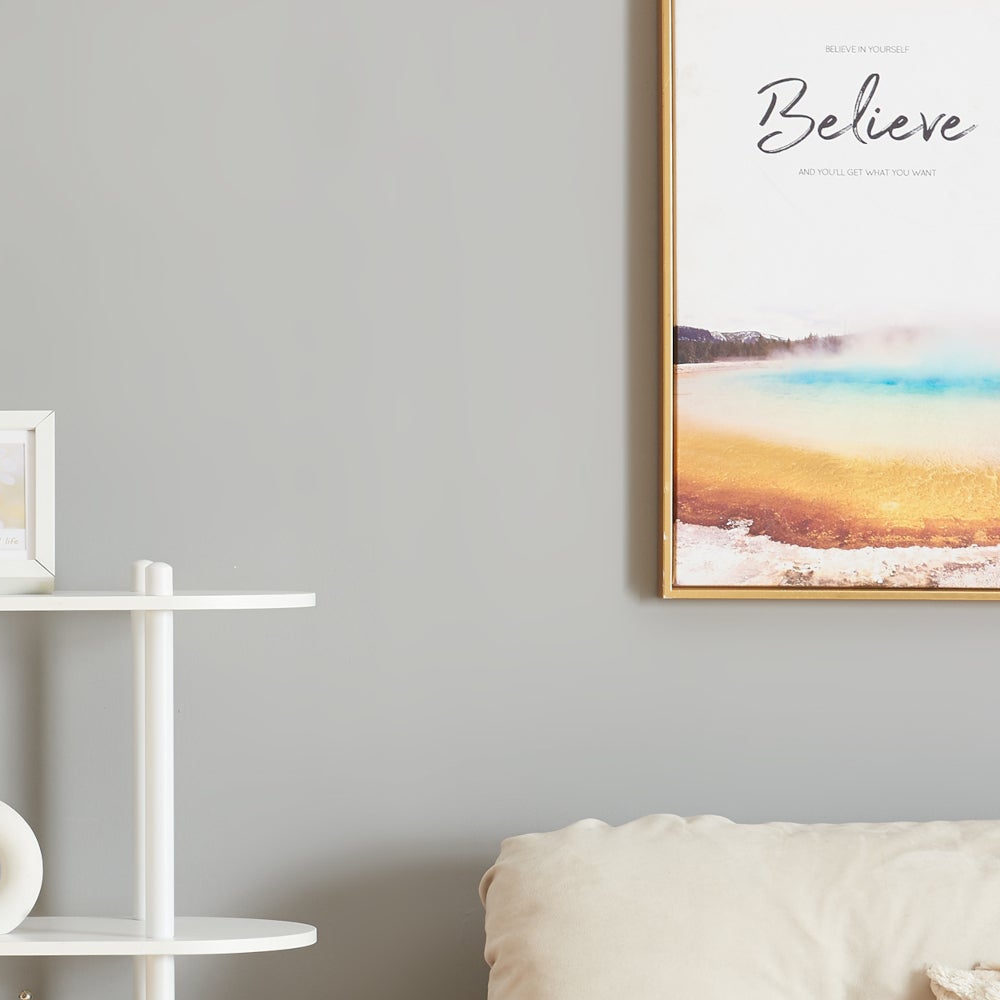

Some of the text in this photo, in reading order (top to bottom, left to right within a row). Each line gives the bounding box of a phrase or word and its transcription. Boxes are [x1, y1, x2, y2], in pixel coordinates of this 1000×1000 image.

[825, 45, 910, 54] BELIEVE IN YOURSELF
[757, 73, 978, 154] Believe
[798, 168, 936, 177] AND YOU'LL GET WHAT YOU WANT
[5, 537, 19, 545] life
